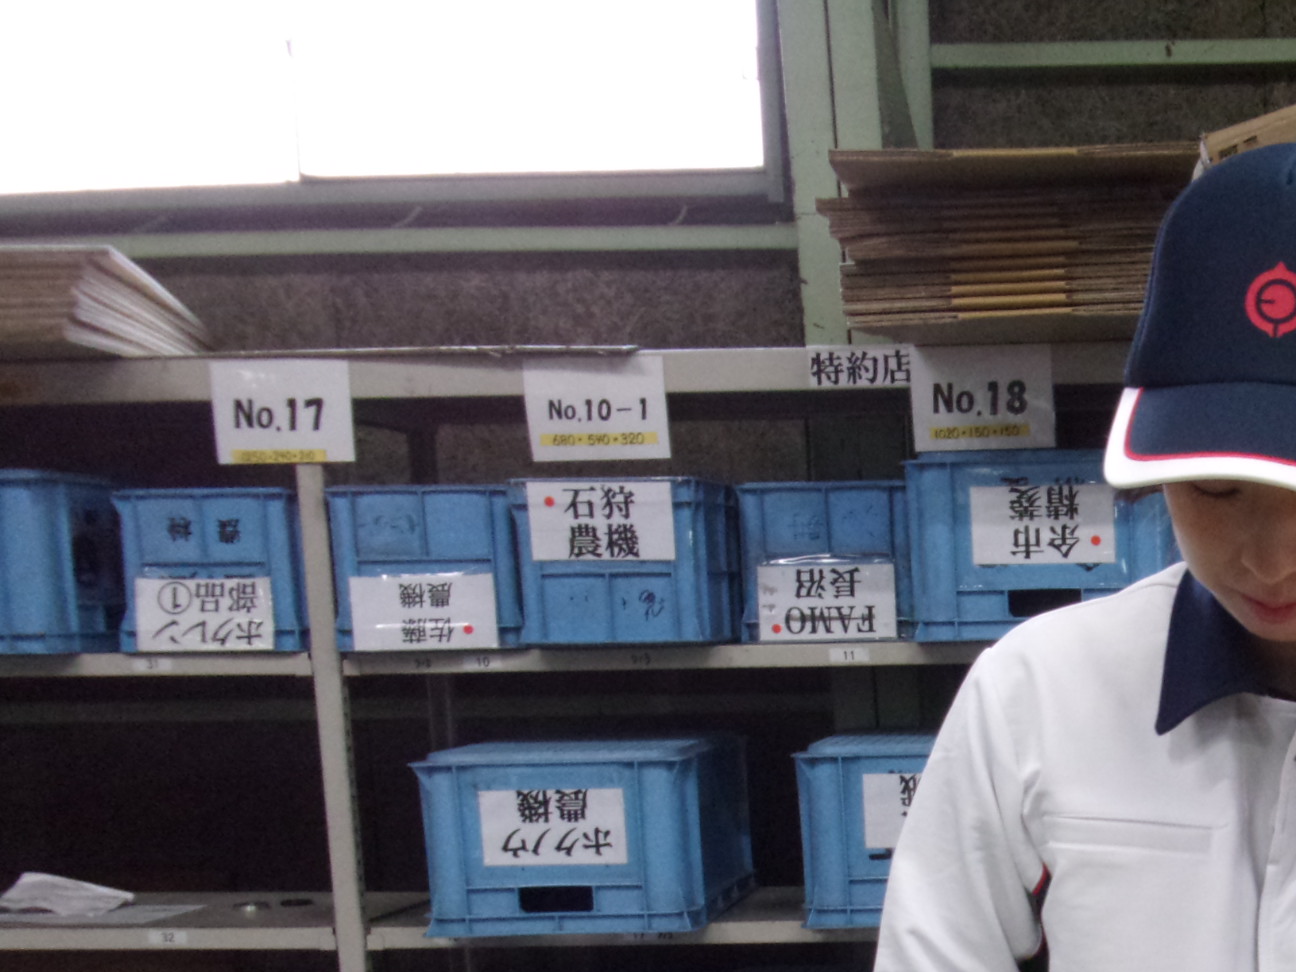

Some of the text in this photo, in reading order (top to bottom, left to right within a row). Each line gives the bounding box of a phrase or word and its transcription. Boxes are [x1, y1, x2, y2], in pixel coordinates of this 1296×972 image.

[810, 350, 911, 385] 特約店
[233, 398, 325, 432] No.17
[932, 381, 1028, 417] No.18
[563, 486, 635, 521] 石狩
[567, 523, 640, 559] 農機
[1010, 523, 1081, 558] 余市
[158, 581, 257, 615] 部品①
[399, 583, 453, 609] 農機
[794, 568, 861, 599] 長沼
[151, 616, 264, 646] ホクレン
[401, 616, 454, 645] 佐藤
[785, 606, 877, 636] FAMO
[517, 789, 589, 821] 農機
[500, 827, 613, 858] ホクノウ
